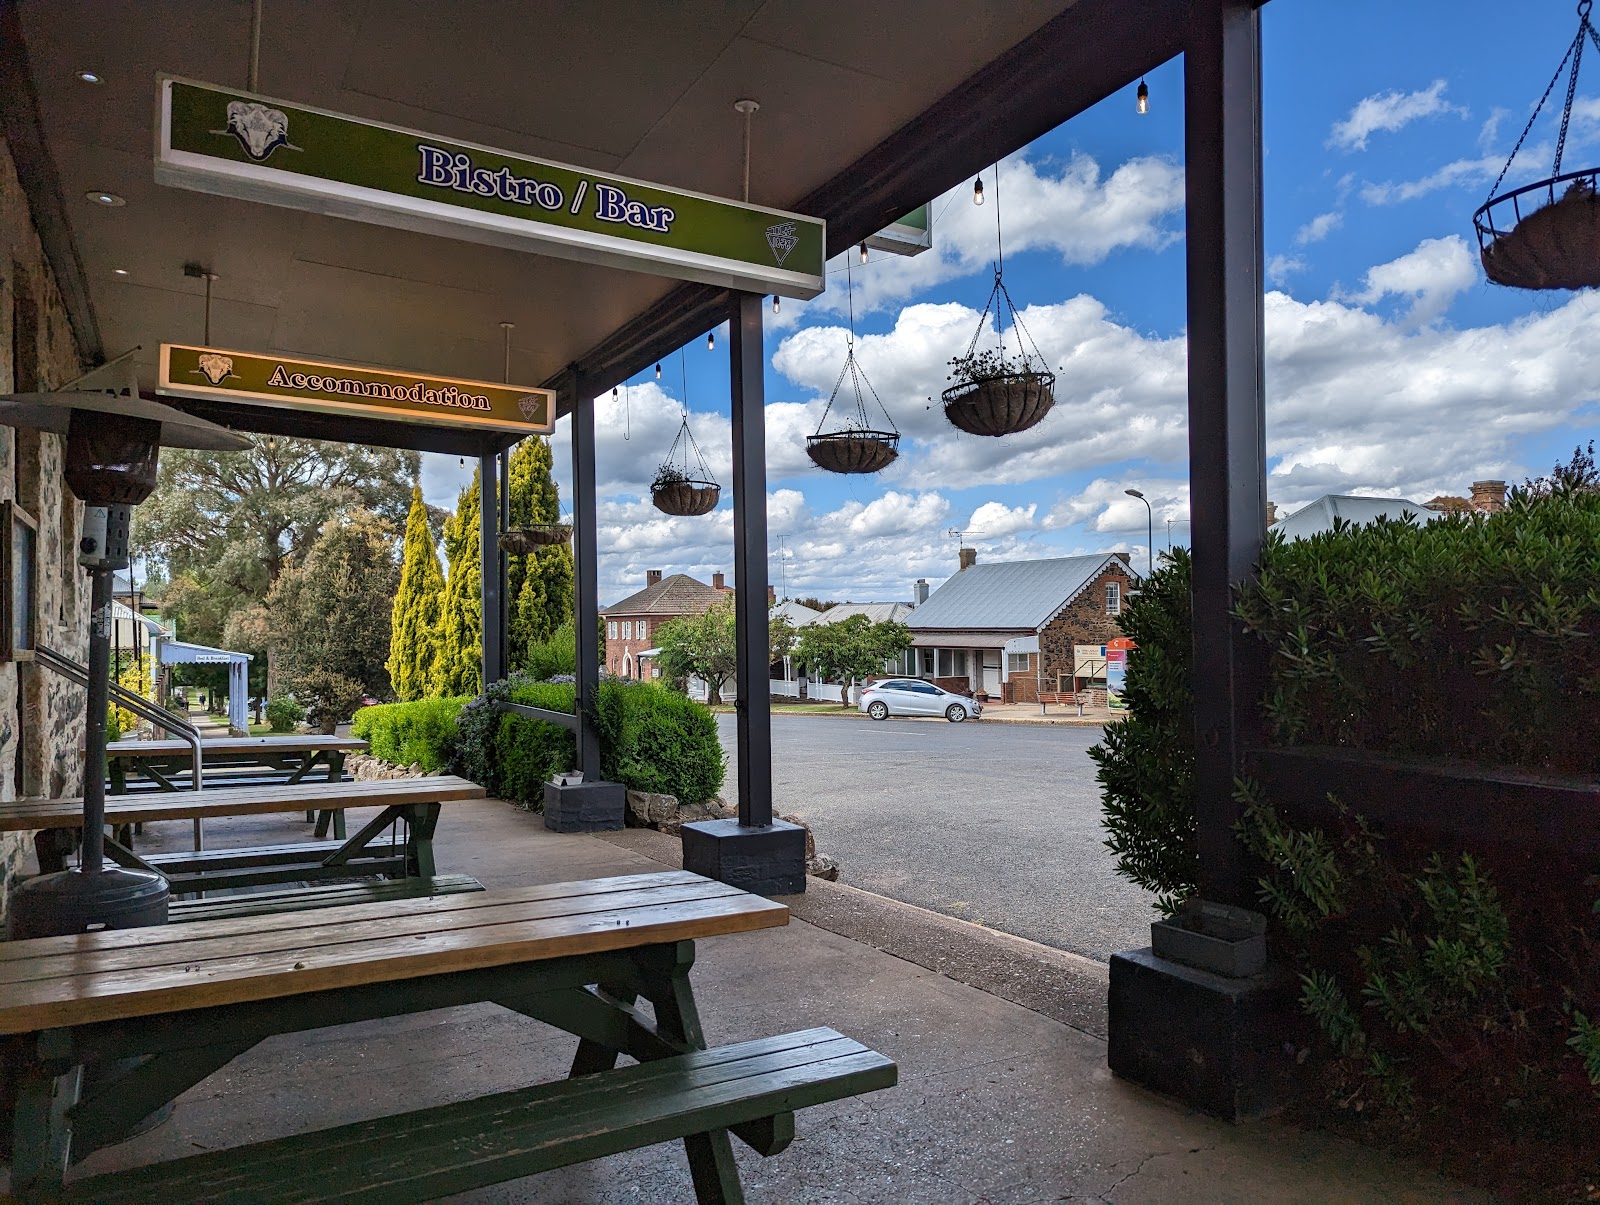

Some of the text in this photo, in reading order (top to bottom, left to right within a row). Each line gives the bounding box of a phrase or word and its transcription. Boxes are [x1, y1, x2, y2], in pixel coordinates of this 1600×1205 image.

[417, 144, 675, 233] Bistro / Bar
[268, 364, 492, 411] Accommodation
